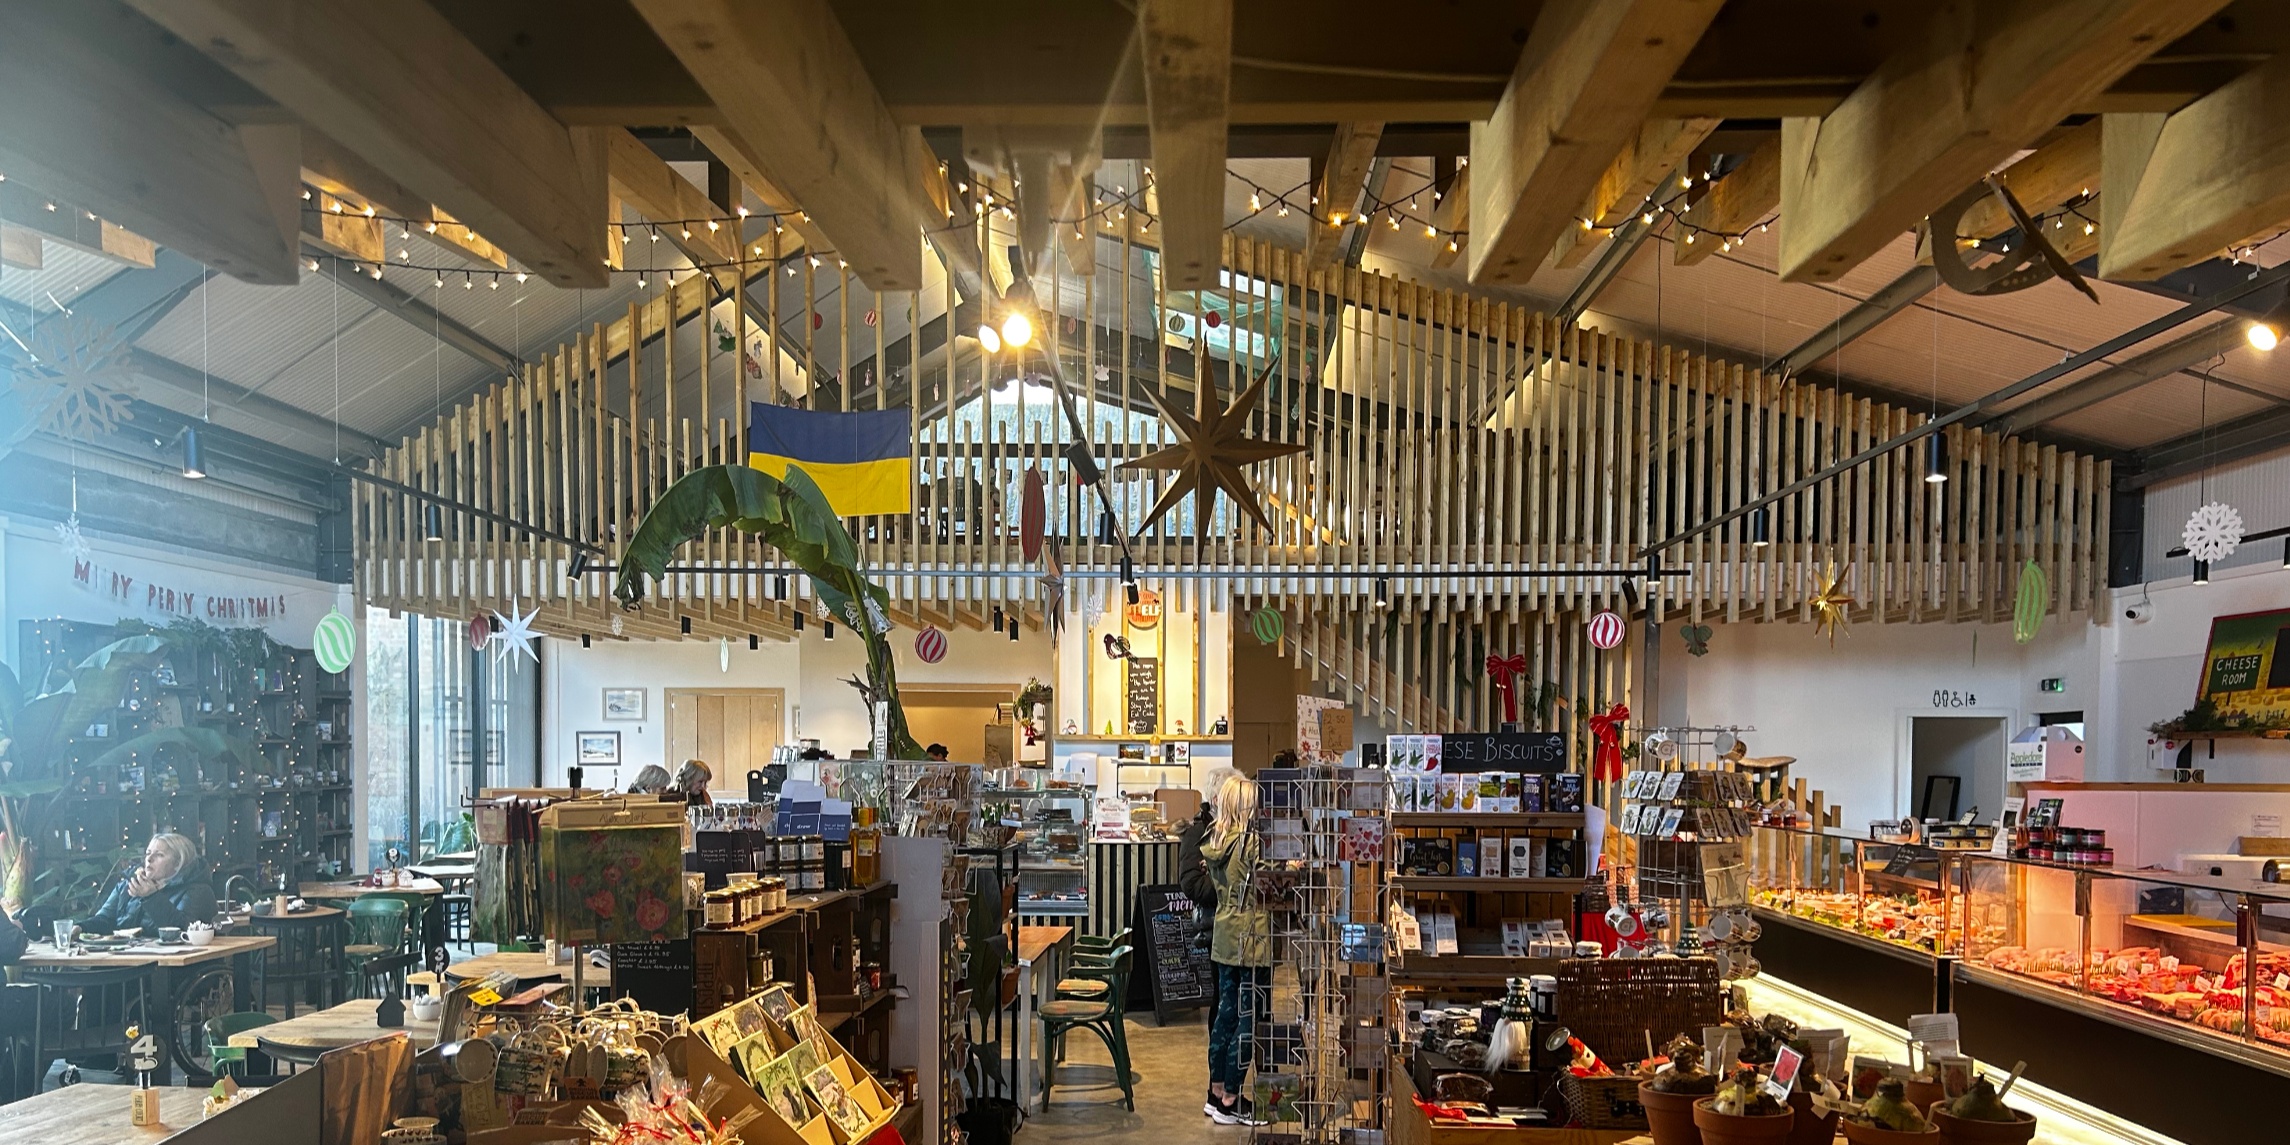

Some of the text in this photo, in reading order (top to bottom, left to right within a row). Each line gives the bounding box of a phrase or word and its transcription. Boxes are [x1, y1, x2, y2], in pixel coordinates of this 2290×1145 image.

[74, 556, 132, 599] MRY
[2216, 656, 2258, 671] CHEESE
[2222, 672, 2247, 686] ROOM
[1444, 737, 1553, 762] ESE BISCUITS
[435, 946, 444, 962] 3
[130, 1034, 158, 1056] 4
